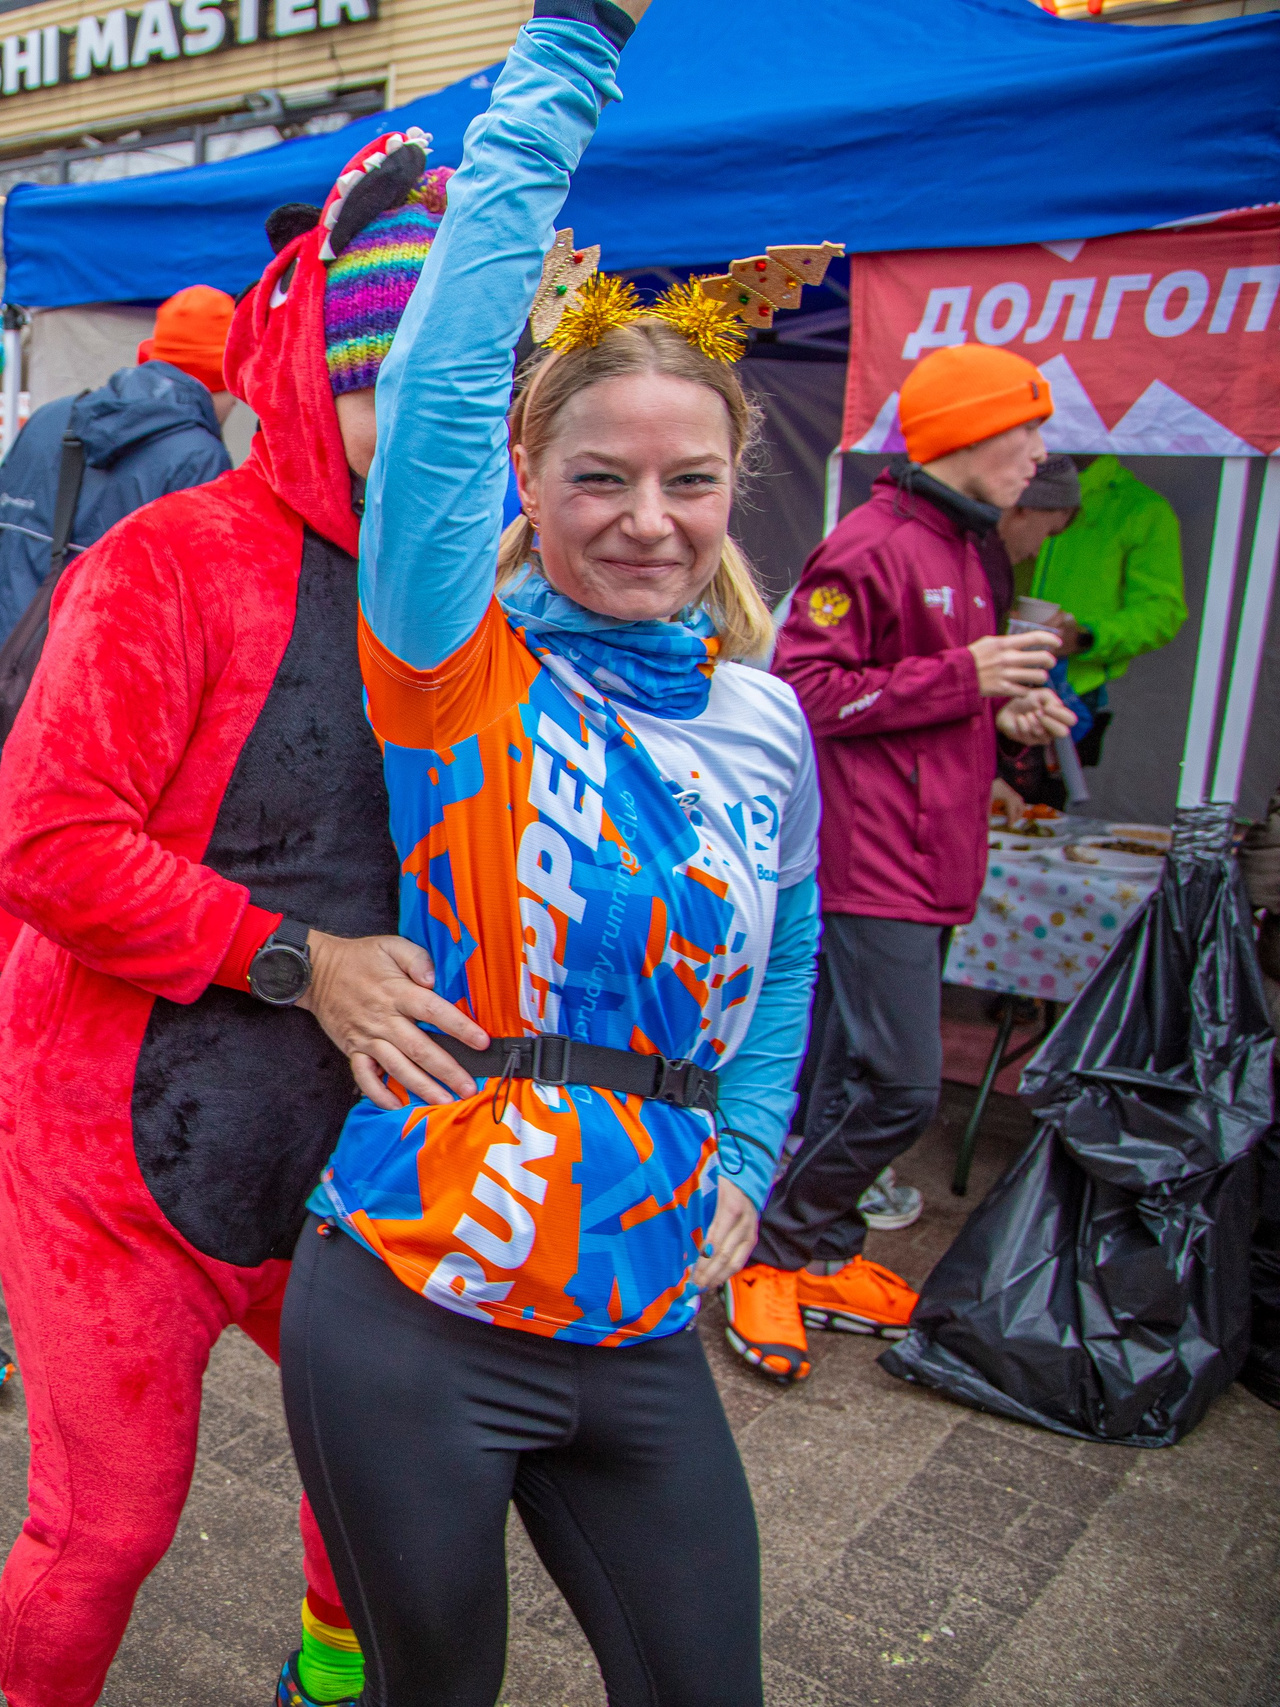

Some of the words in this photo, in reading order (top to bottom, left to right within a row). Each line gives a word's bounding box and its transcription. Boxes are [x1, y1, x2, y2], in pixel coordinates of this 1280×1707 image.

[901, 263, 1280, 360] ДОЛГОП
[615, 787, 638, 843] club
[600, 844, 642, 951] running
[421, 1101, 558, 1325] RUN
